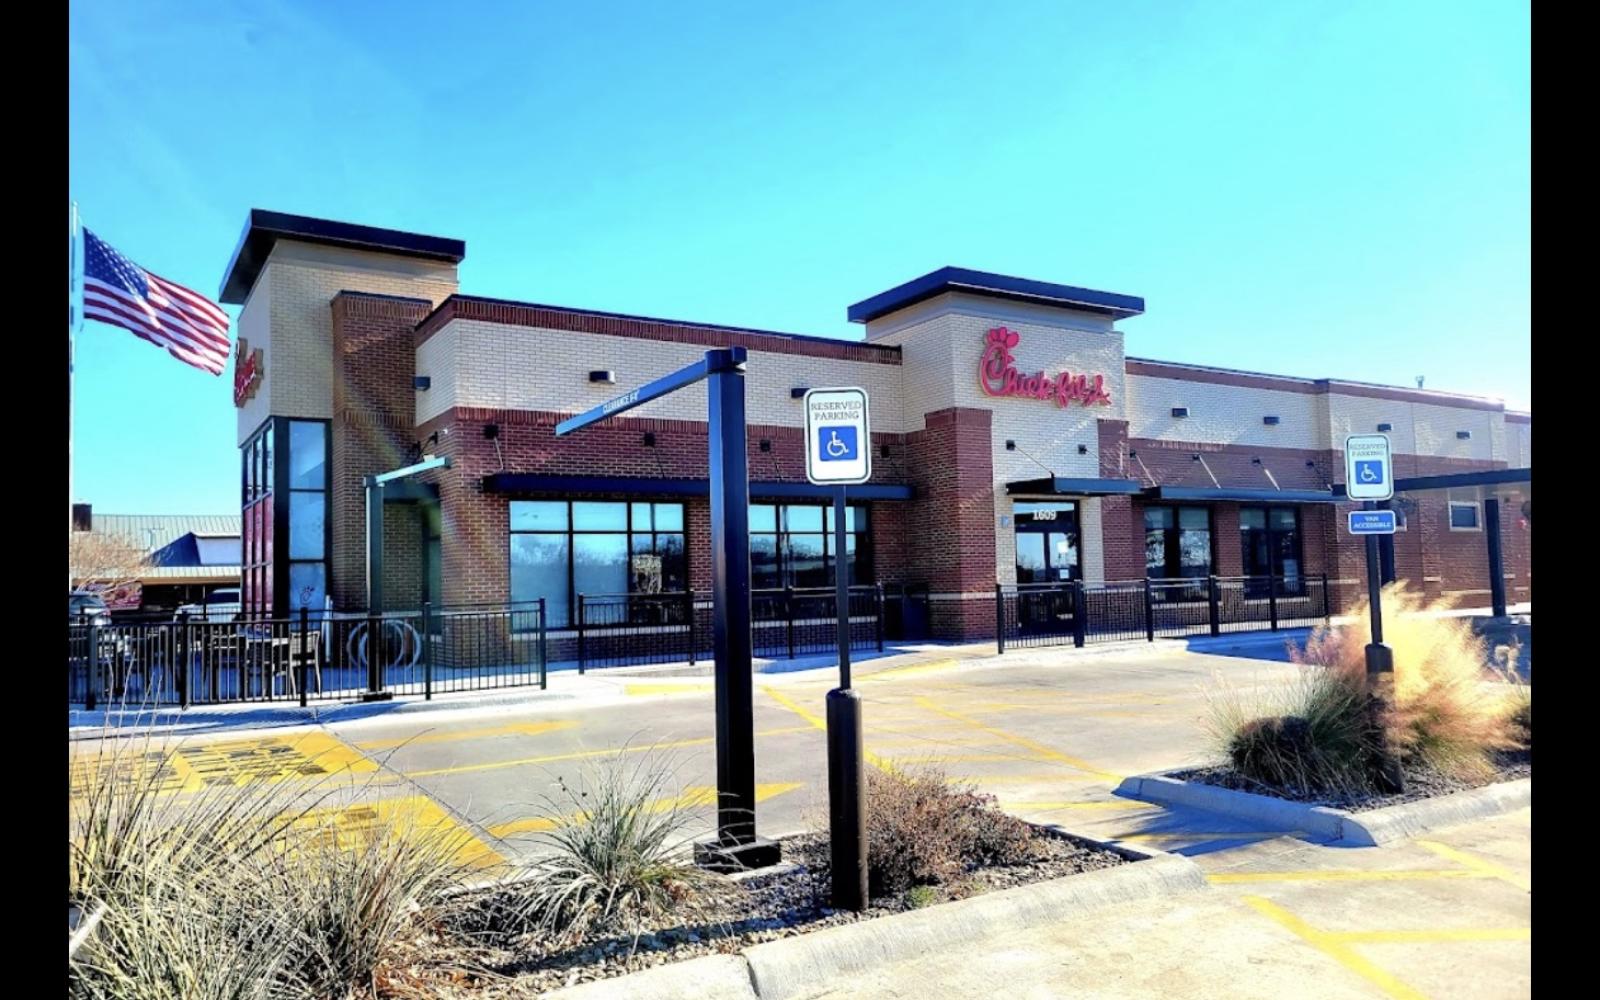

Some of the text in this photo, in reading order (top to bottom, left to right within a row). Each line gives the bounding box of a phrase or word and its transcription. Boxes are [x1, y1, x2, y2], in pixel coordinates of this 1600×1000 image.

[980, 327, 1112, 408] Chick-fil-A
[811, 401, 862, 411] RESERVED
[814, 411, 860, 420] PARKING
[1033, 510, 1057, 520] 1609
